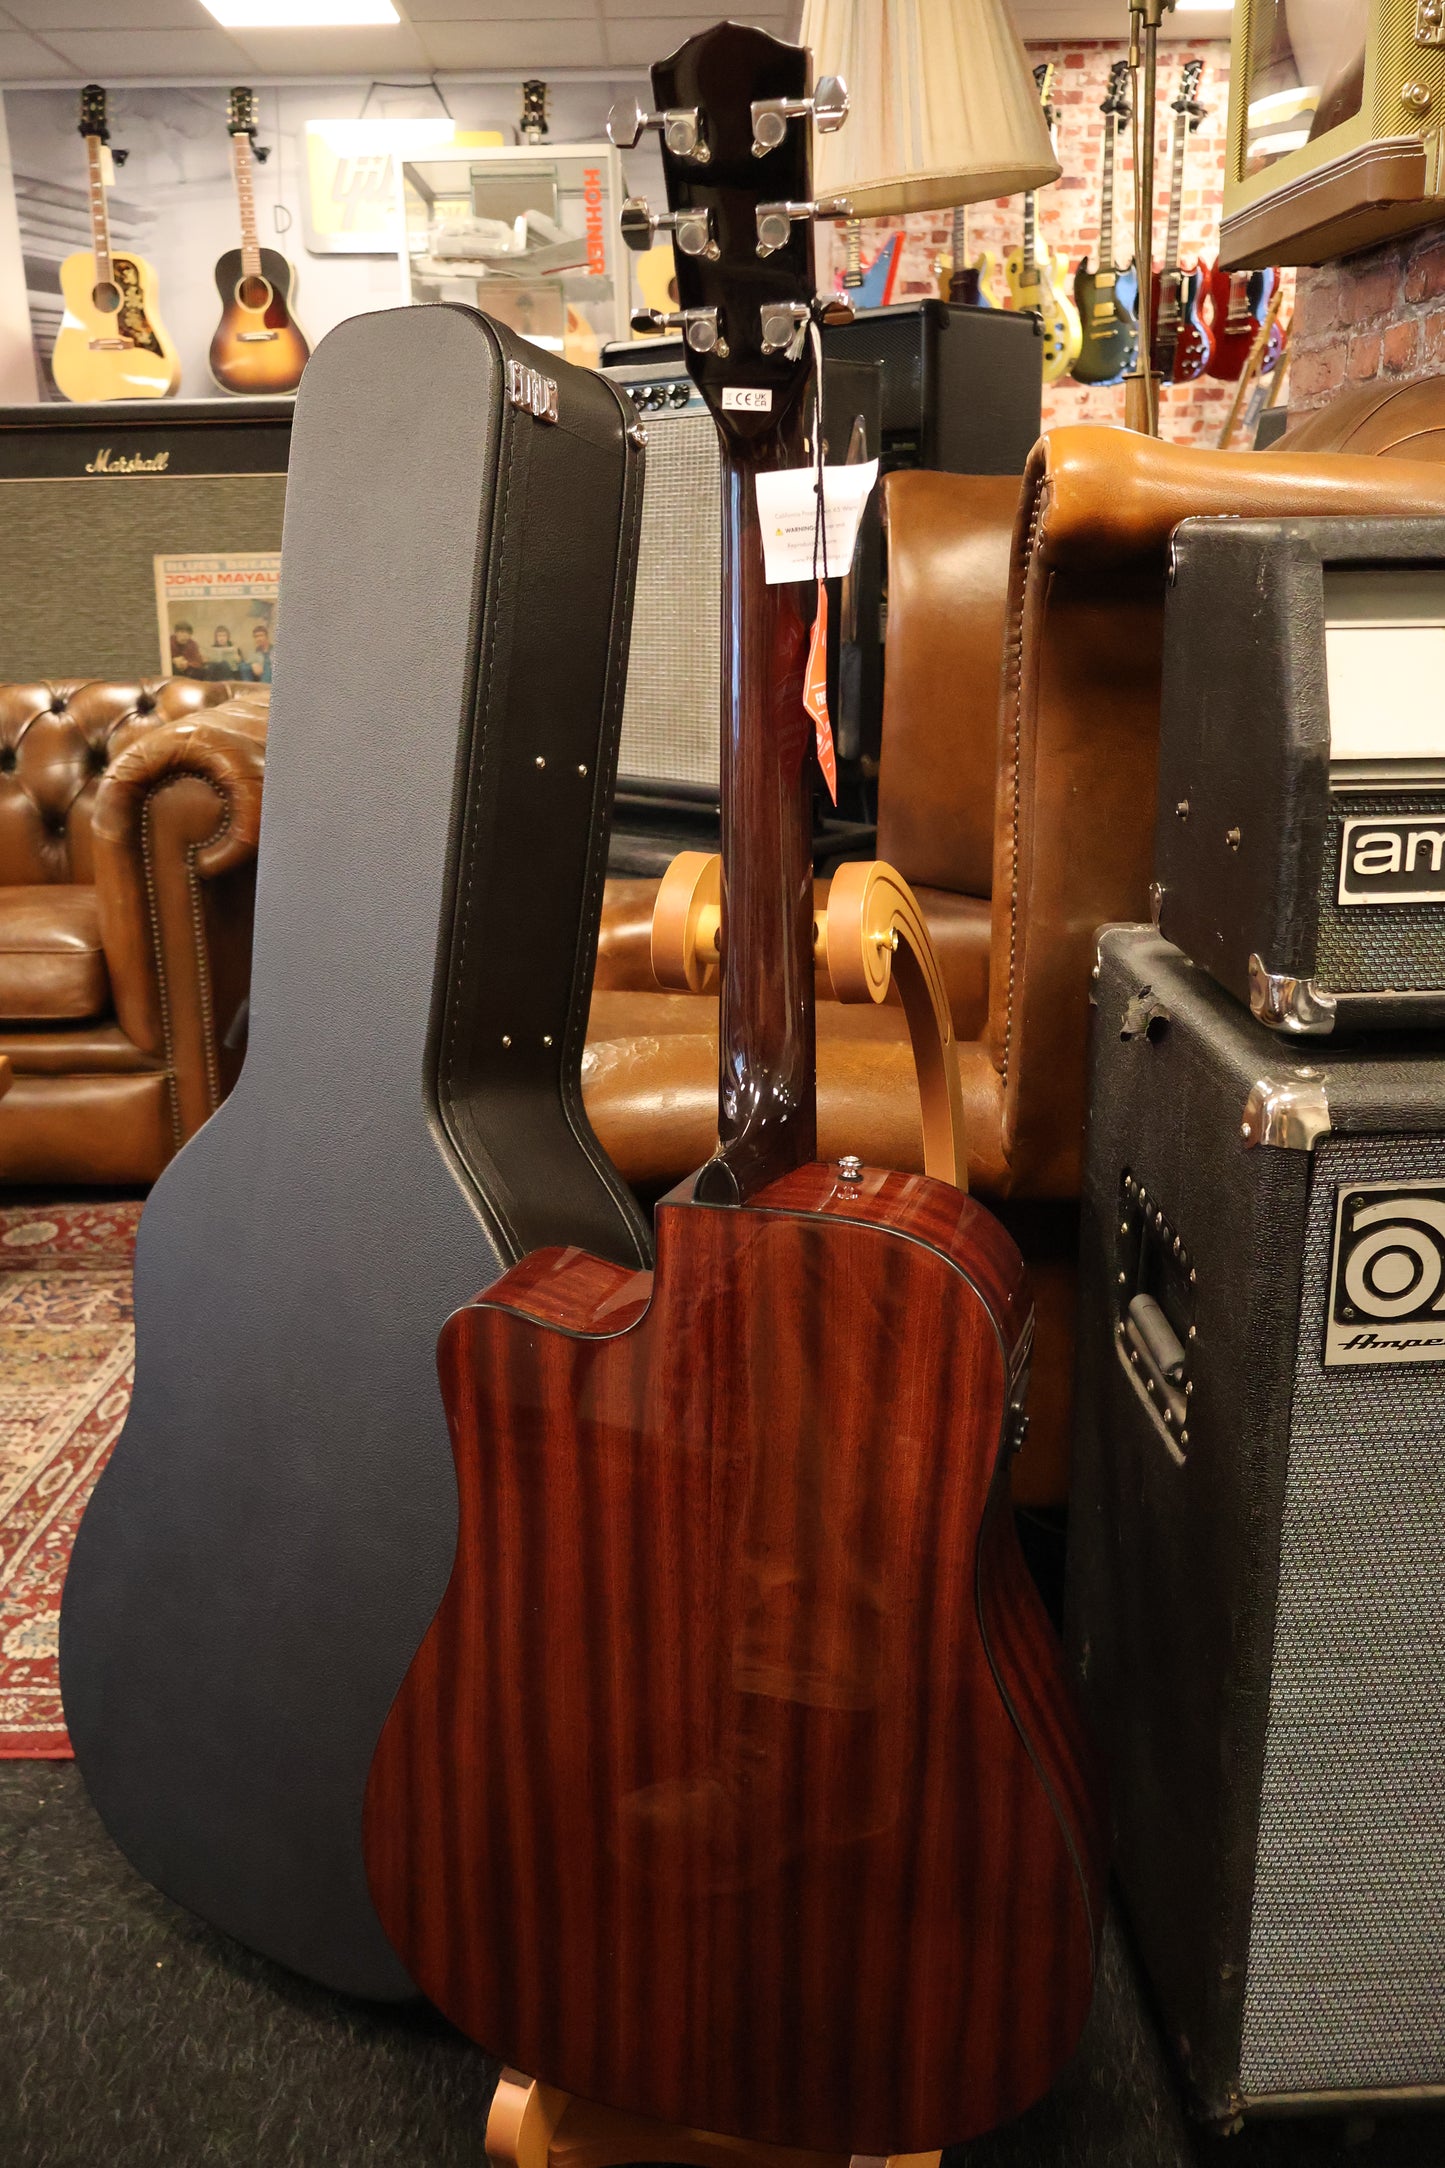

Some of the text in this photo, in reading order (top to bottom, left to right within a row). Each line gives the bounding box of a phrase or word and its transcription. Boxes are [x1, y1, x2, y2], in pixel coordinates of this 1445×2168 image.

[583, 169, 605, 275] HOHNER
[85, 448, 170, 473] Marshall
[165, 575, 213, 585] JOHN
